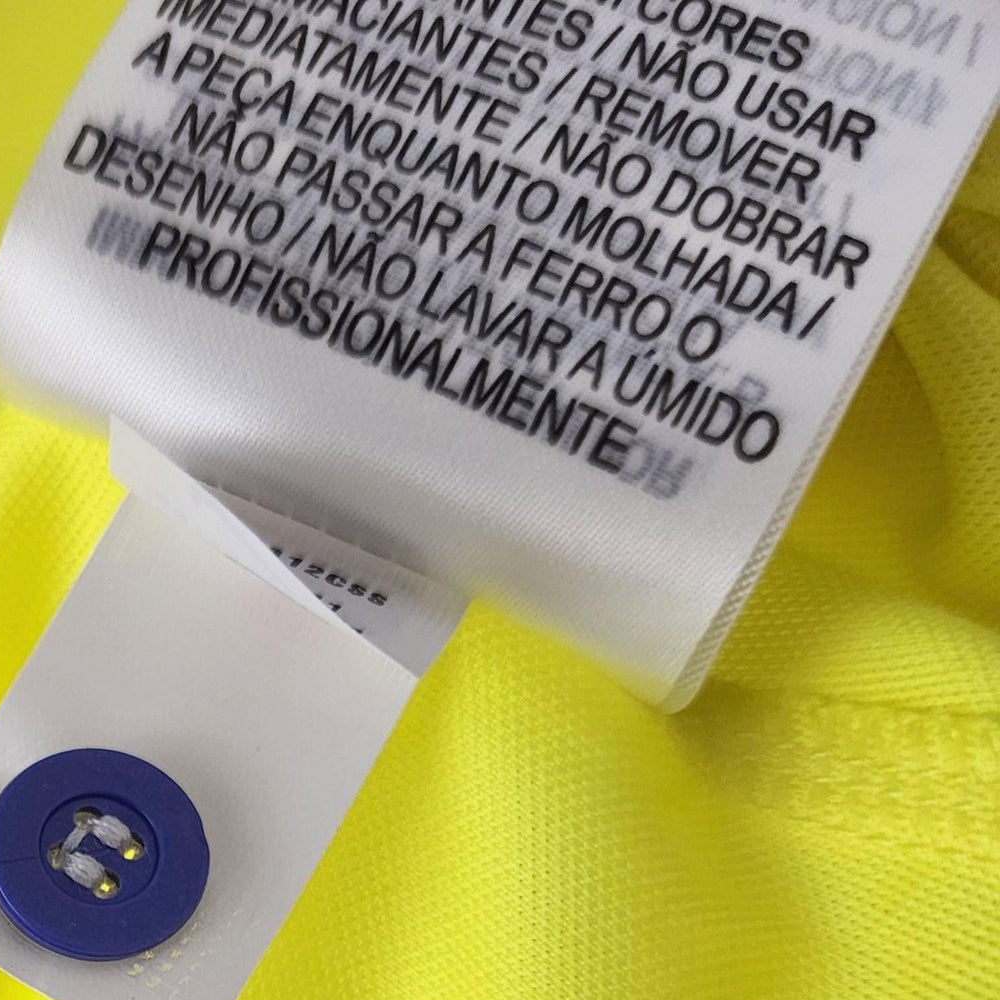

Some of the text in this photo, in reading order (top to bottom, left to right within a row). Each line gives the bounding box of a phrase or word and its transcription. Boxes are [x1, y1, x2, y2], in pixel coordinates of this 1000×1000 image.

[131, 31, 172, 79] A
[171, 43, 297, 126] PEÇA
[295, 92, 561, 226] ENQUANTO
[558, 195, 800, 335] MOLHADA
[280, 0, 548, 95] ACIANTES
[544, 66, 579, 104] /
[570, 75, 822, 205] REMOVER
[512, 115, 548, 154] /
[540, 124, 653, 198] NÃO
[651, 170, 870, 291] DOBRAR
[590, 24, 625, 62] /
[618, 32, 730, 103] NÃO
[733, 73, 877, 162] USAR
[63, 123, 286, 247] DESENHO
[308, 223, 418, 302] NÃO
[416, 270, 574, 374] LAVAR
[566, 340, 608, 393] A
[611, 348, 782, 464] ÚMIDO
[137, 221, 638, 475] PROFISSIONALMENTE
[170, 102, 724, 364] NÃO PASSAR A FERRO O
